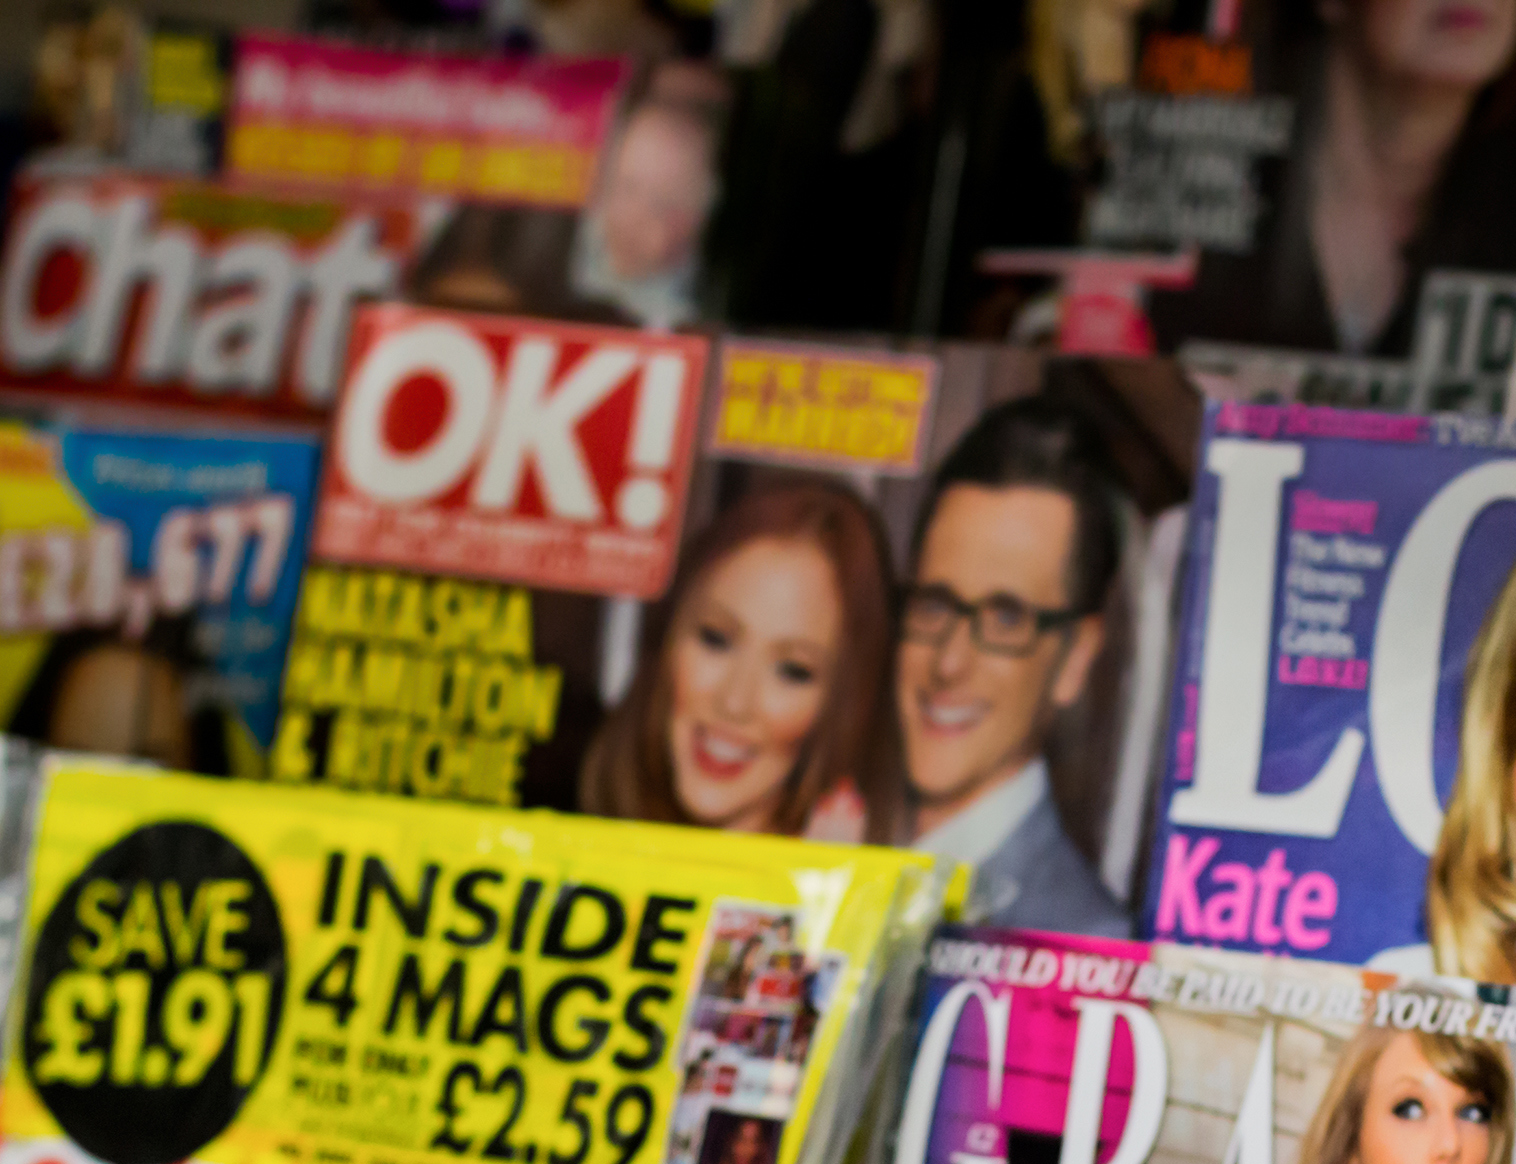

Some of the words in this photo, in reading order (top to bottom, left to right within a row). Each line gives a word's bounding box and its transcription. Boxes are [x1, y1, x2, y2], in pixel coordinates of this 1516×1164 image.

[335, 322, 688, 532] OK!
[68, 876, 254, 970] SAVE
[318, 850, 698, 976] INSIDE
[1153, 832, 1340, 952] Kate
[35, 966, 272, 1087] £1.91
[302, 944, 360, 1028] 4
[382, 953, 676, 1073] MAGS
[930, 937, 1060, 990] SHOULD
[1062, 952, 1138, 998] YOU
[1181, 970, 1268, 1018] PAID
[1268, 981, 1317, 1020] TO
[1316, 987, 1366, 1024] BE
[1371, 990, 1473, 1038] YOUR
